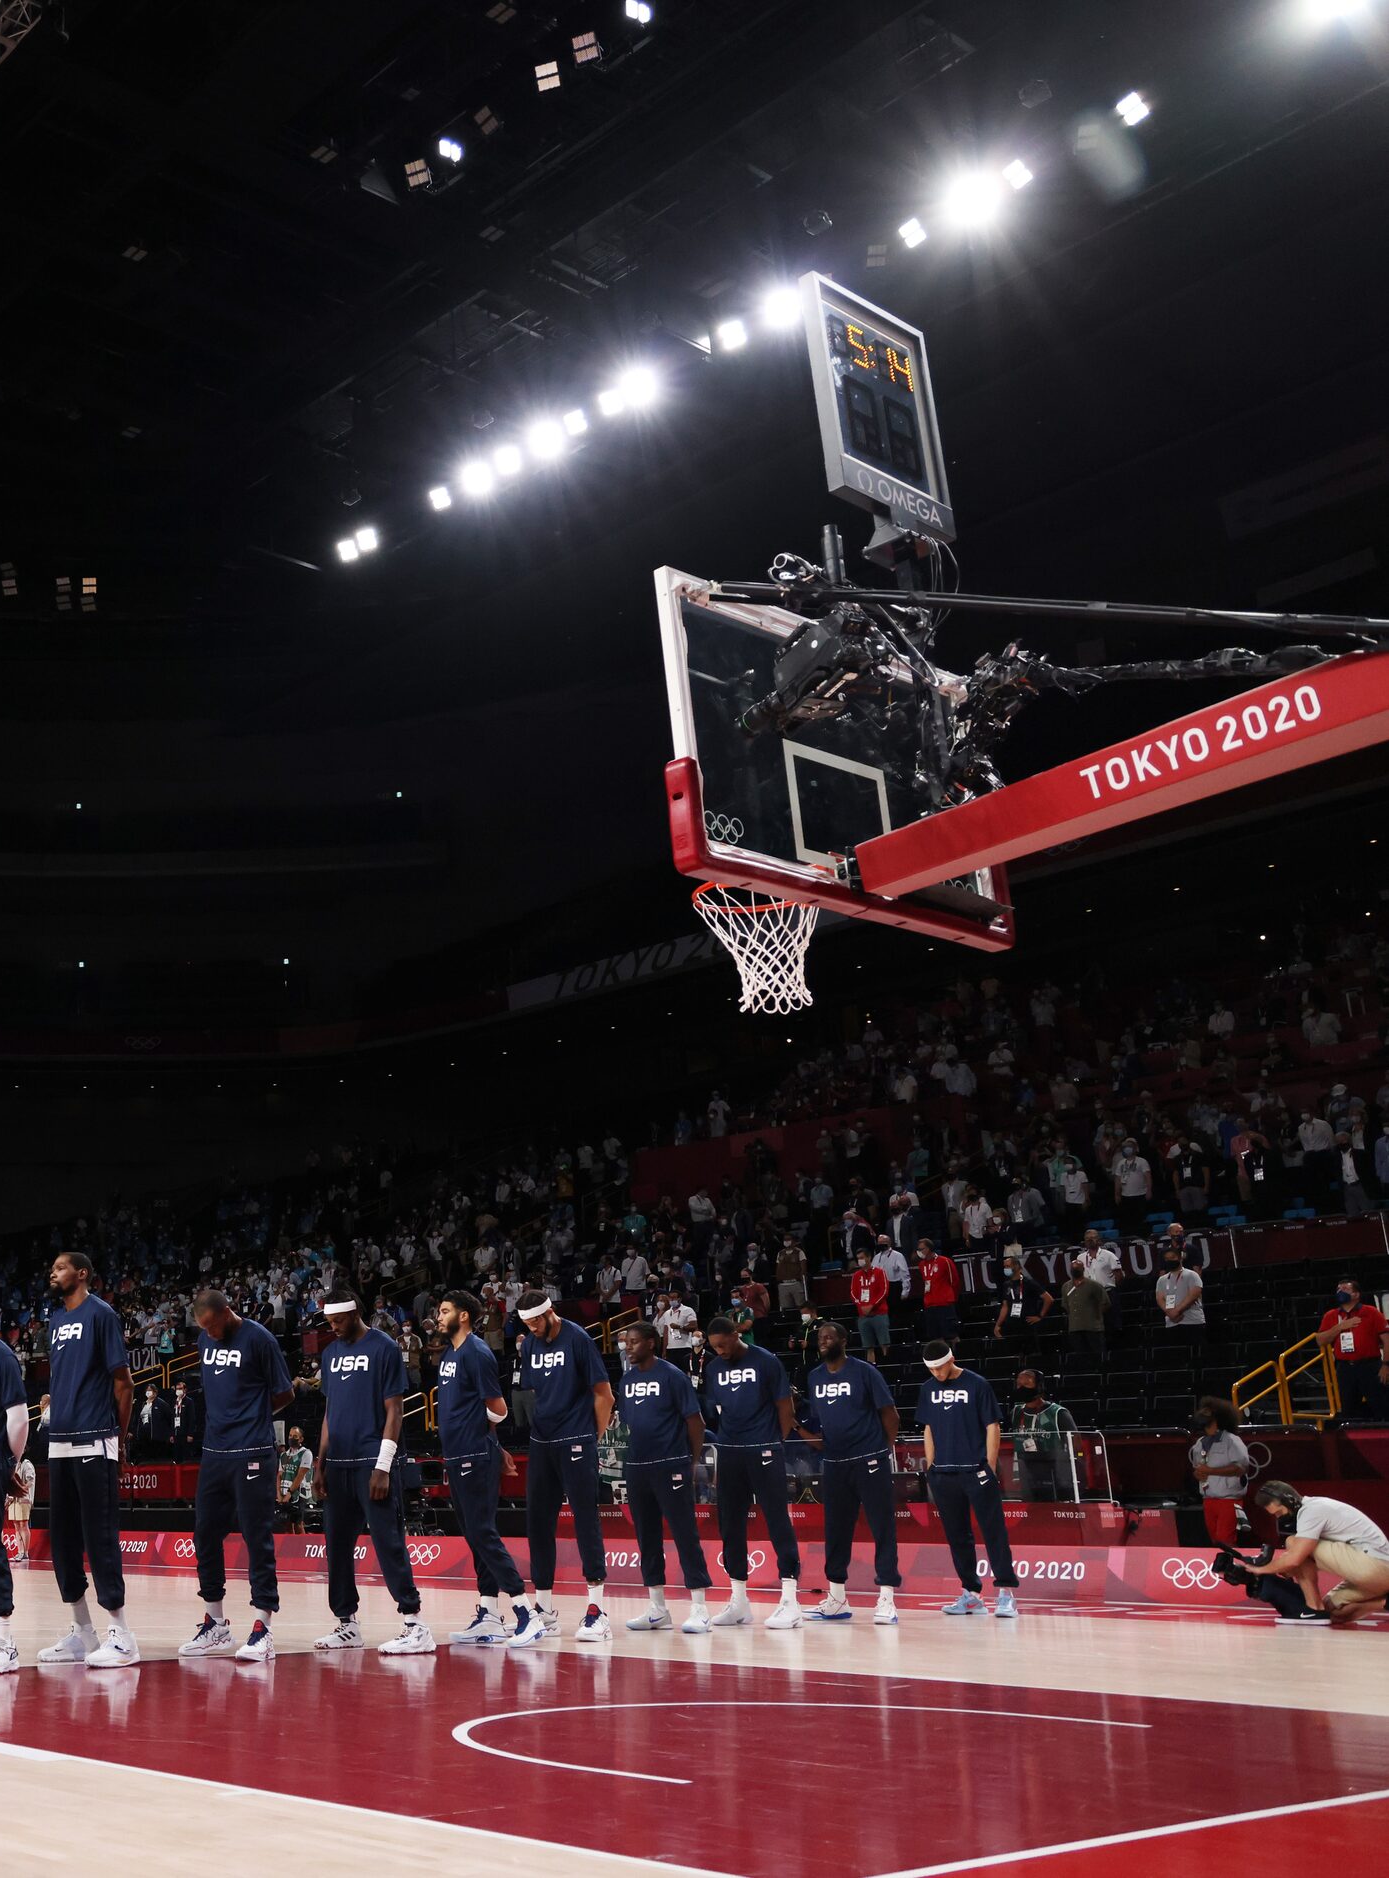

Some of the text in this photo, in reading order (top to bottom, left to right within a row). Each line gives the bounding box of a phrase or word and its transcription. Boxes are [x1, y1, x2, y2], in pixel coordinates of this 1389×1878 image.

[846, 323, 914, 392] 5:14
[877, 479, 943, 528] OMEGA
[1079, 685, 1322, 799] TOKYO 2020
[554, 940, 677, 1000] TOKYO
[51, 1323, 83, 1344] USA
[202, 1348, 242, 1368] USA
[330, 1354, 369, 1373] USA
[530, 1351, 565, 1369] USA
[439, 1361, 457, 1378] USA
[717, 1367, 757, 1385] USA
[624, 1381, 660, 1399] USA
[814, 1381, 851, 1399] USA
[930, 1388, 969, 1405] USA
[133, 1474, 157, 1489] 2020
[126, 1540, 148, 1553] 2020
[1033, 1561, 1086, 1580] 2020
